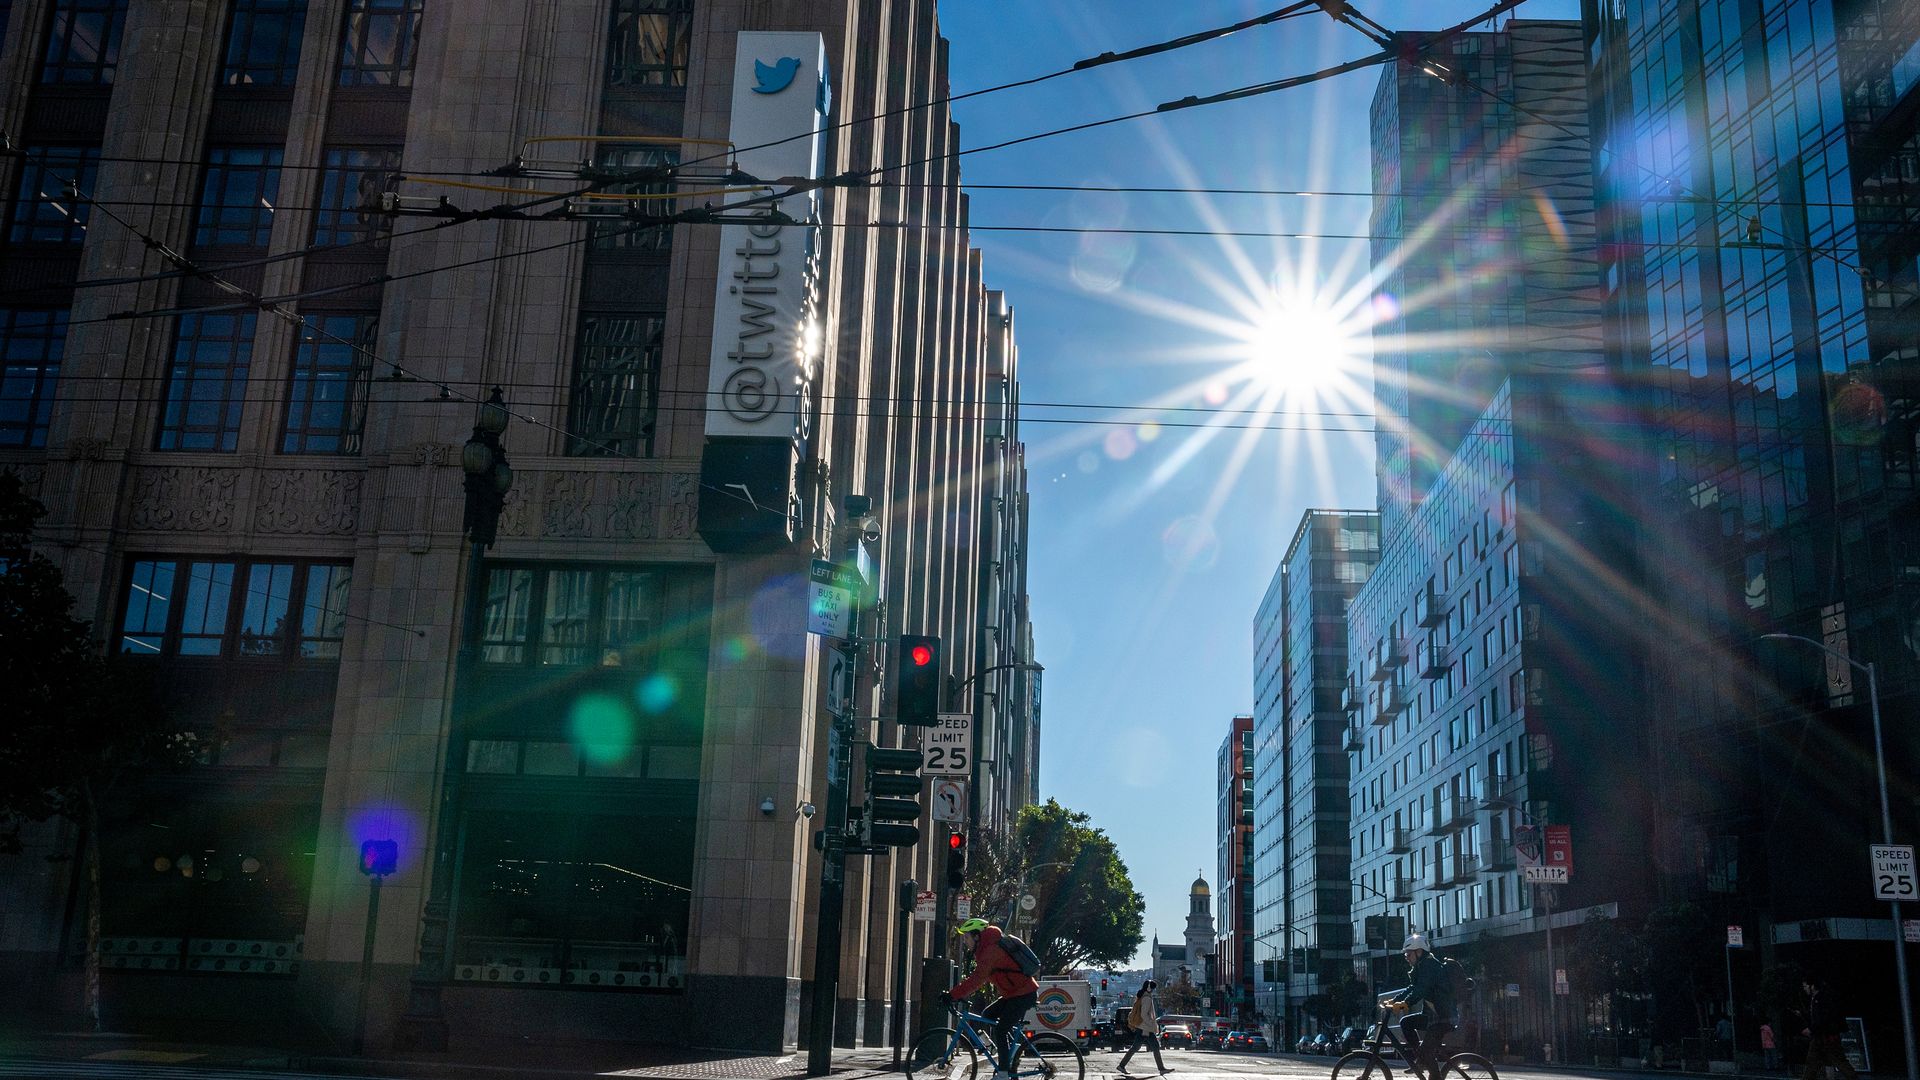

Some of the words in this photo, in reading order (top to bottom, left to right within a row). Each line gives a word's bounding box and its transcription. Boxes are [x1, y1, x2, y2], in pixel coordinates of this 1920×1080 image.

[812, 566, 830, 579] LEFT
[832, 571, 851, 584] LANE
[818, 588, 833, 600] BUS
[835, 593, 841, 601] &
[820, 600, 837, 611] TAXI
[818, 610, 839, 622] ONLY
[929, 719, 969, 729] PEED
[931, 733, 964, 743] LIMIT
[927, 747, 967, 770] 25
[1875, 850, 1911, 860] SPEED
[1879, 862, 1908, 872] LIMIT
[1879, 875, 1913, 895] 25
